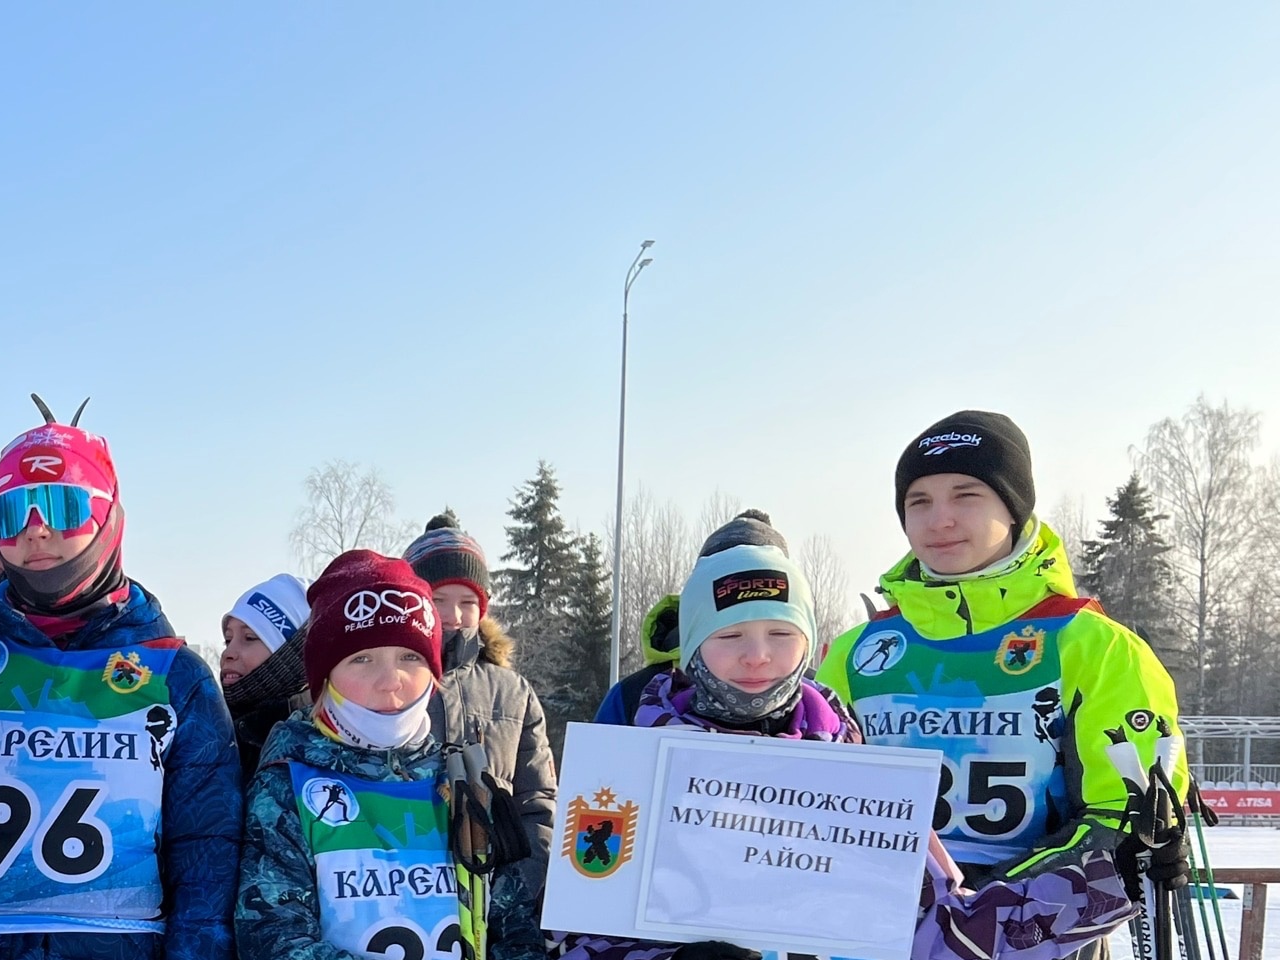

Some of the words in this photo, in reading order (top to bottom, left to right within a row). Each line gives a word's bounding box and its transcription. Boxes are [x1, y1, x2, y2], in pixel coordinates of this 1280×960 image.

[918, 431, 982, 449] Reebok
[716, 578, 787, 599] SPORTS
[344, 616, 375, 633] PEACE
[379, 614, 407, 625] LOVE
[863, 710, 1023, 737] КАРЕЛИЯ
[686, 776, 916, 821] КОНДОПОЖСКИЙ
[668, 805, 921, 853] МУНИЦИПАЛЬНЫЙ
[743, 845, 833, 874] РАЙОН
[333, 865, 458, 899] КАРЕЛ
